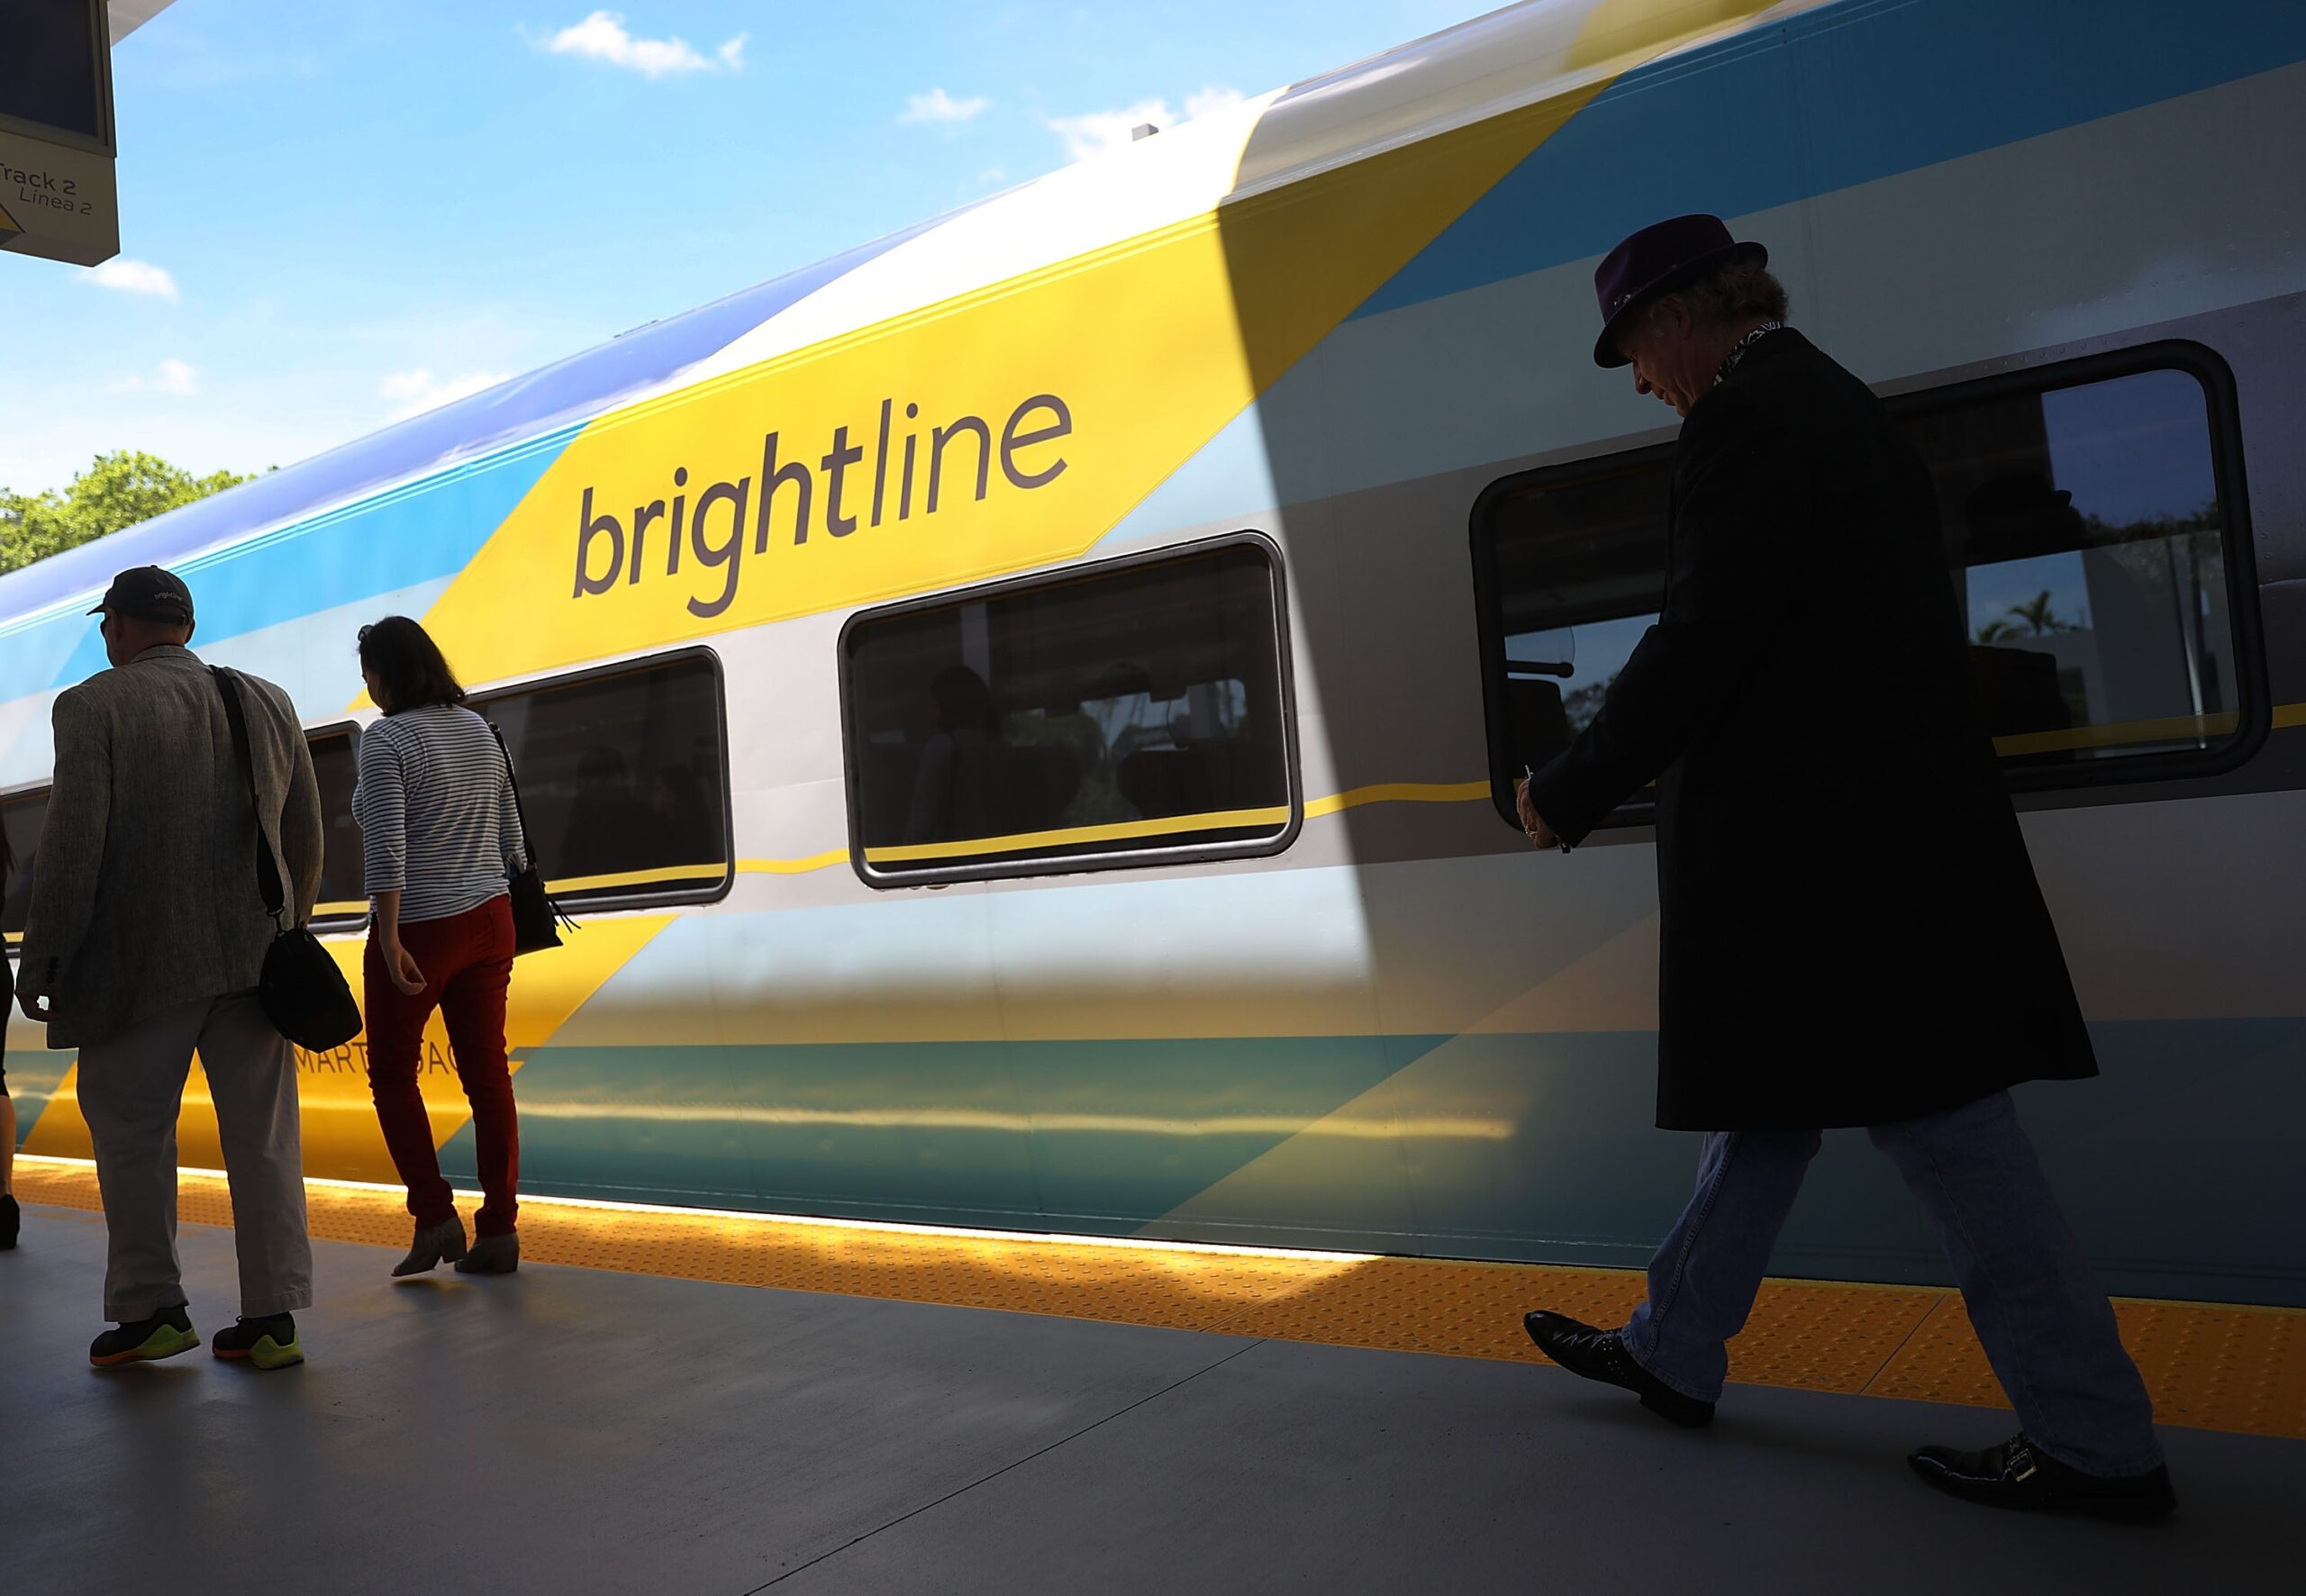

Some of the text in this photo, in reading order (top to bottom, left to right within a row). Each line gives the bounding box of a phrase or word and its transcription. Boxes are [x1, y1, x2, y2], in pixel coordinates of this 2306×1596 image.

[63, 179, 77, 195] 2
[79, 203, 92, 215] 2
[573, 394, 1073, 619] brightline
